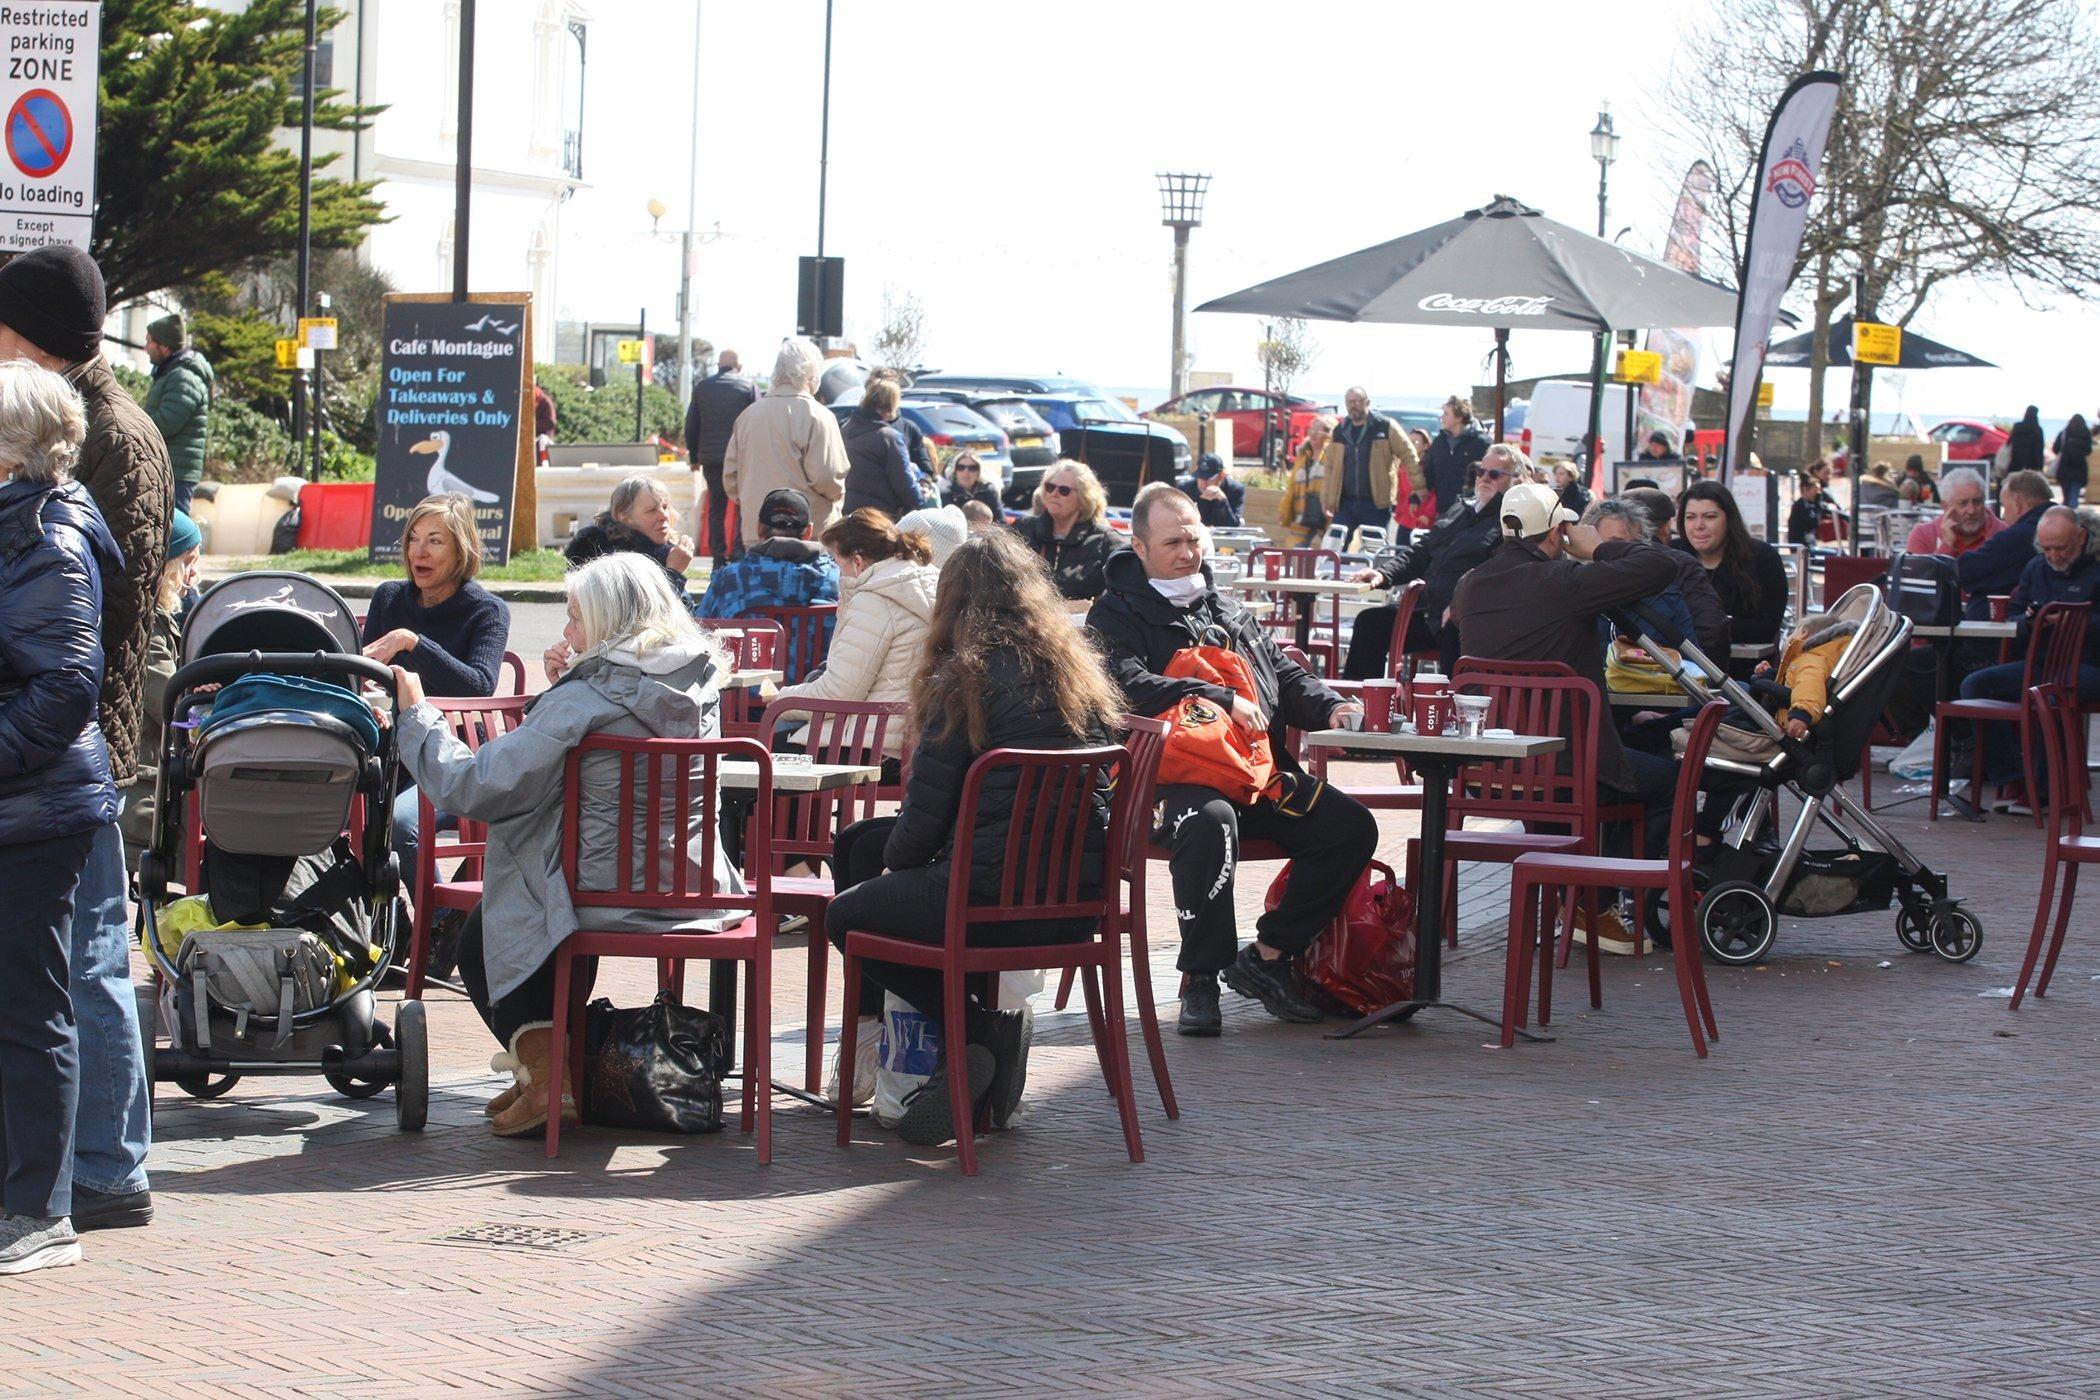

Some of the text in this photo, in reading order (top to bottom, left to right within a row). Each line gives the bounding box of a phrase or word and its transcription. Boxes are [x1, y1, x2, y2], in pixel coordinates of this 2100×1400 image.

[1, 8, 88, 27] Restricted
[11, 33, 75, 53] parking
[9, 58, 73, 81] ZONE
[0, 182, 84, 208] o loading
[17, 218, 55, 233] Except
[9, 233, 45, 247] signed
[431, 339, 514, 359] Montague
[389, 367, 466, 385] Open For
[388, 388, 495, 407] Takeaways &
[387, 409, 512, 428] Deliveries Only
[1427, 704, 1436, 731] COSTA
[1207, 823, 1233, 901] AROUND
